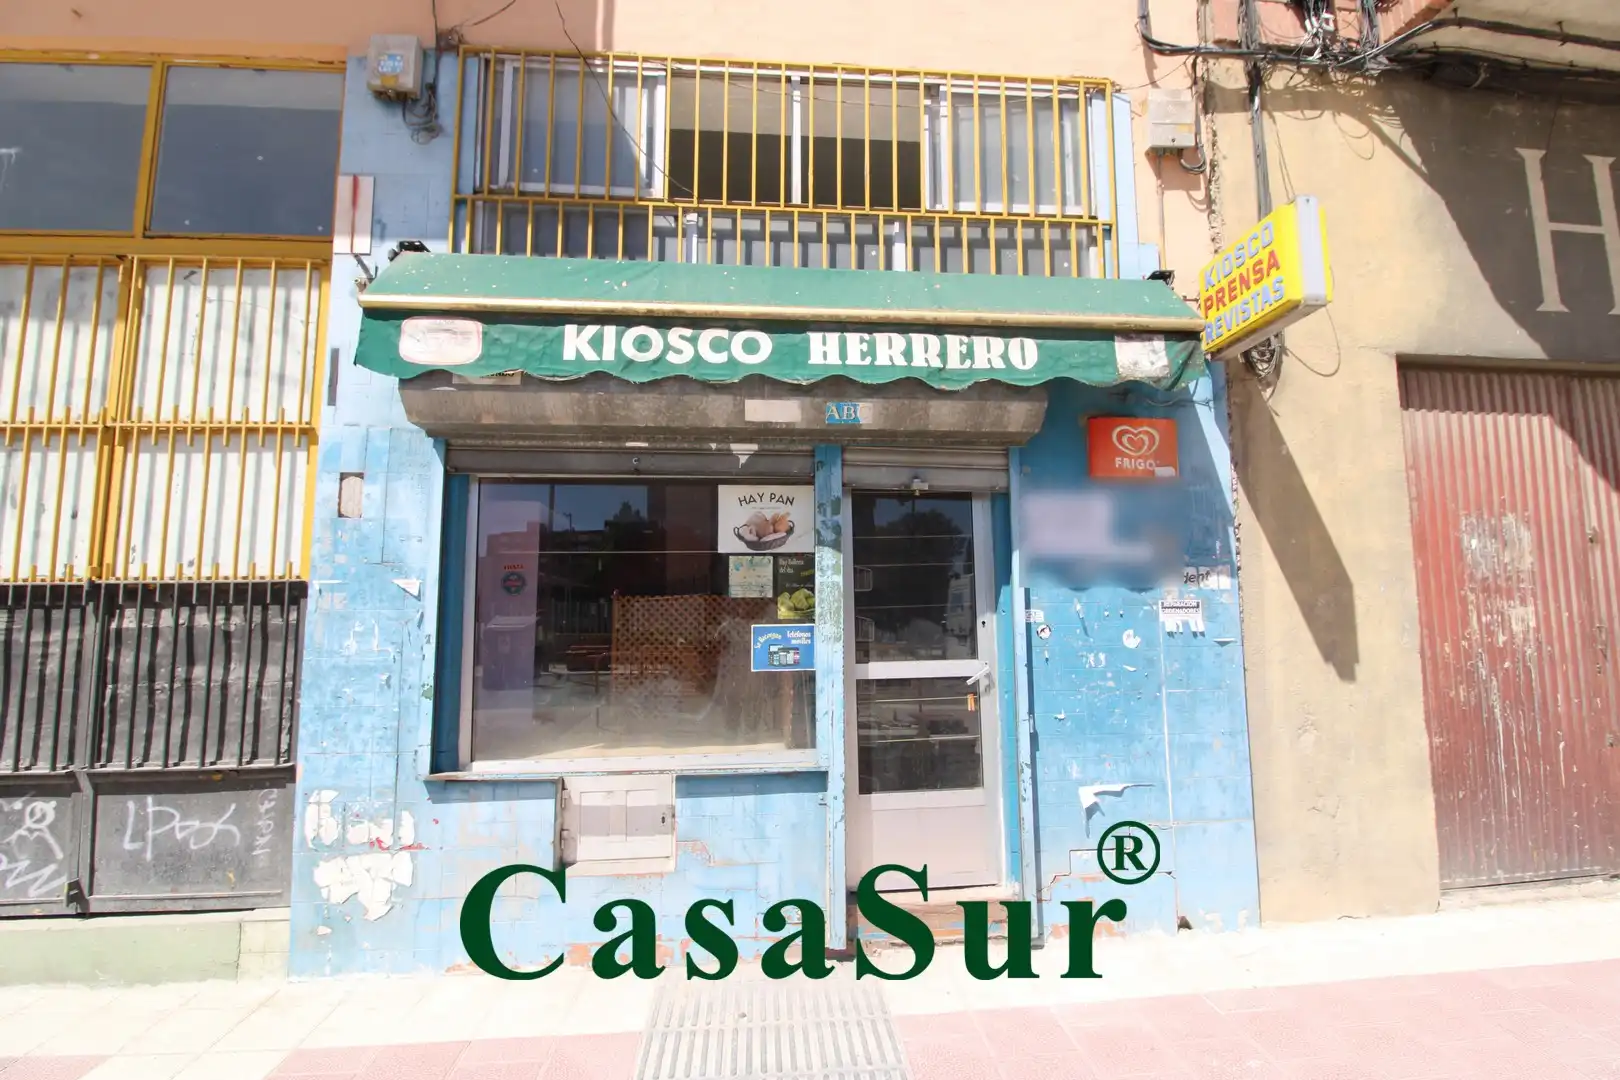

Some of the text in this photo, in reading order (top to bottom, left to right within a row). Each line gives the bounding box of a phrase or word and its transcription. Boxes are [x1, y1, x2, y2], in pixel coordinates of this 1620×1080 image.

[1203, 249, 1281, 320] PRENSA
[1204, 221, 1275, 293] KIOSCO
[1204, 275, 1286, 346] REVISTAS
[563, 323, 1039, 371] KIOSCO HERRERO
[1115, 457, 1156, 471] FRIGO
[738, 492, 795, 507] HAY PAN
